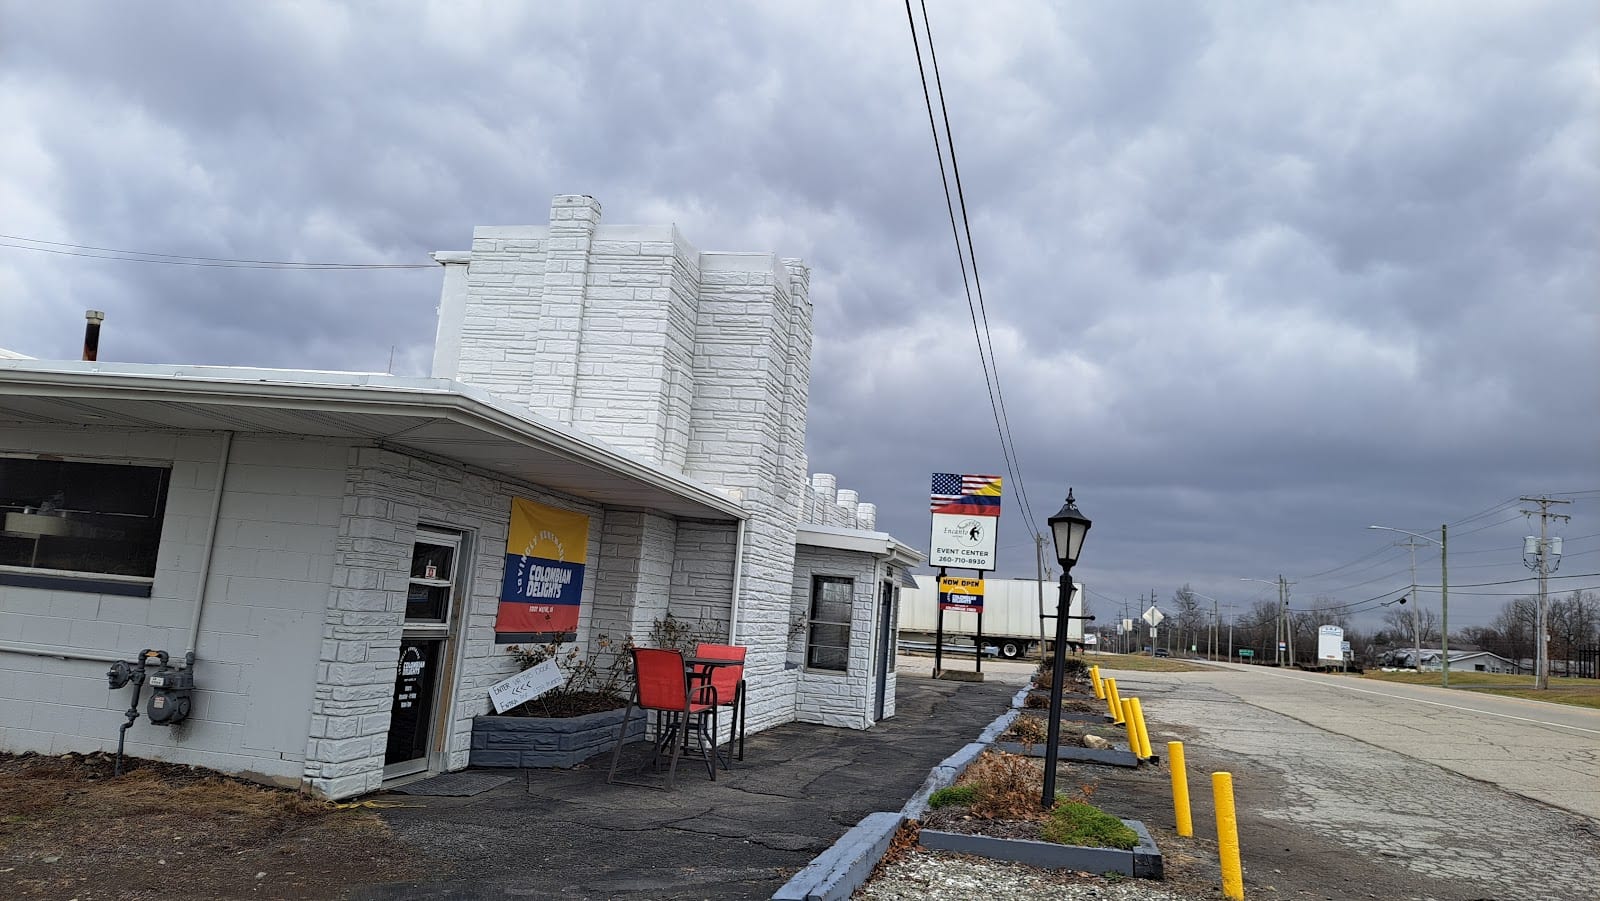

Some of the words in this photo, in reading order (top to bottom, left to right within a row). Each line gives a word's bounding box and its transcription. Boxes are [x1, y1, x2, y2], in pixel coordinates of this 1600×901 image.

[936, 547, 959, 555] EVENT
[961, 549, 989, 557] CENTER
[516, 535, 538, 594] LOVINGLY
[938, 556, 986, 565] 260-710-8930
[528, 564, 572, 584] COLOMBIAN
[525, 580, 563, 598] DELIGHTS
[942, 578, 958, 586] NOW
[961, 580, 980, 588] OPEN
